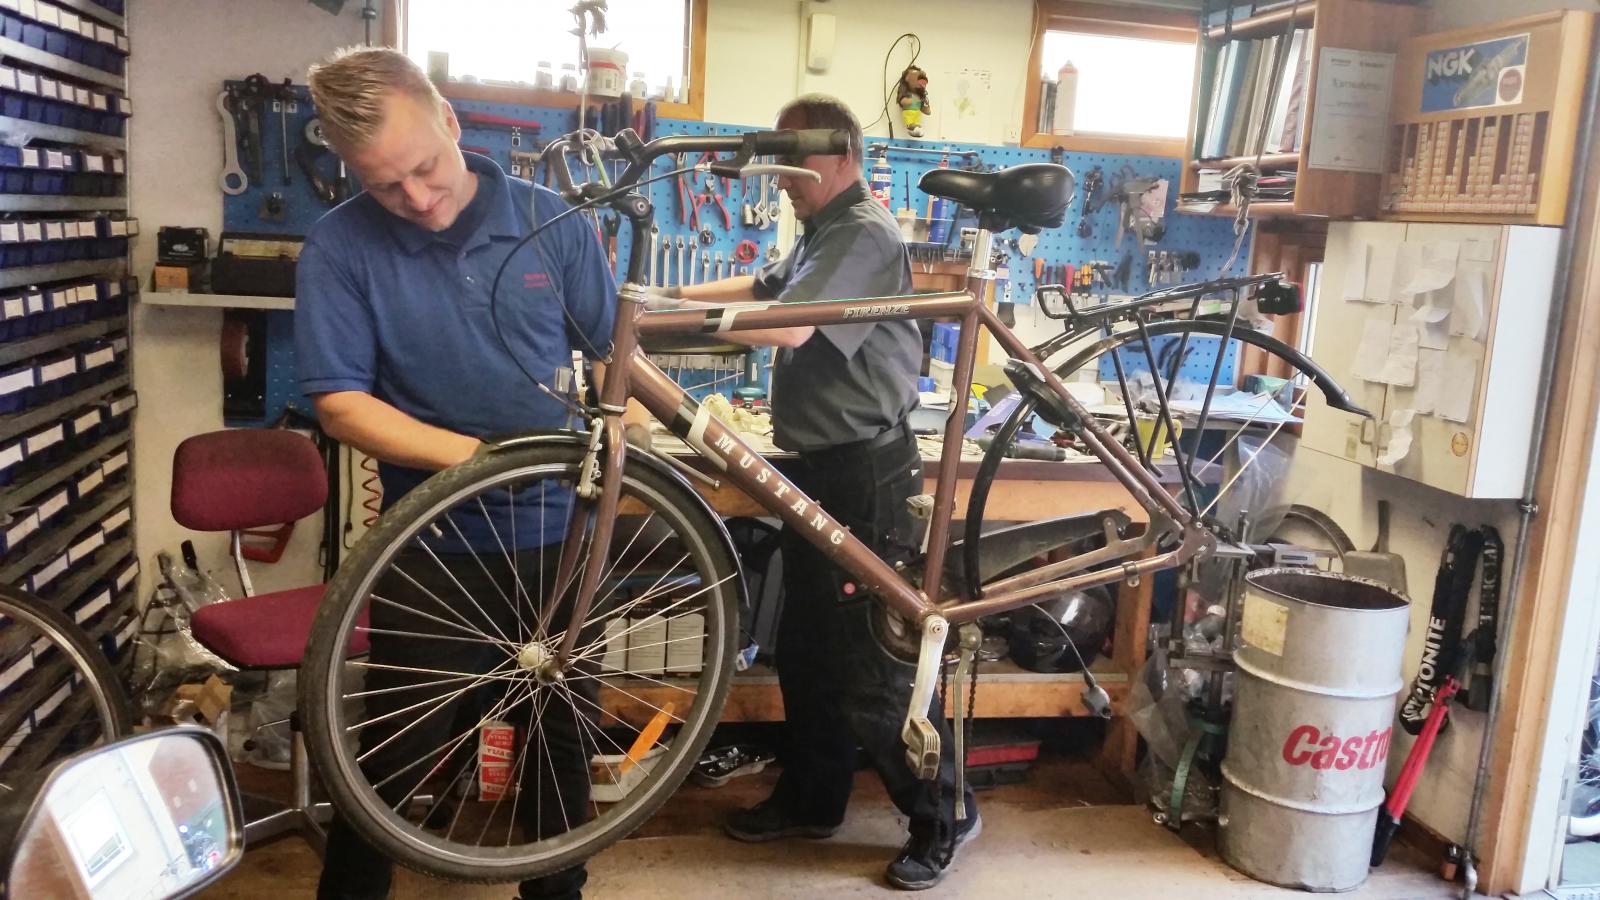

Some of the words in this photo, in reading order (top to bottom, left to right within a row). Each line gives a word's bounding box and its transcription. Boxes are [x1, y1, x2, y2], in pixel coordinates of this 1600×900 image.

[1427, 48, 1475, 81] NGK
[843, 304, 910, 318] FIRENZE
[714, 433, 845, 545] MUSTANG
[1282, 725, 1393, 770] Castro
